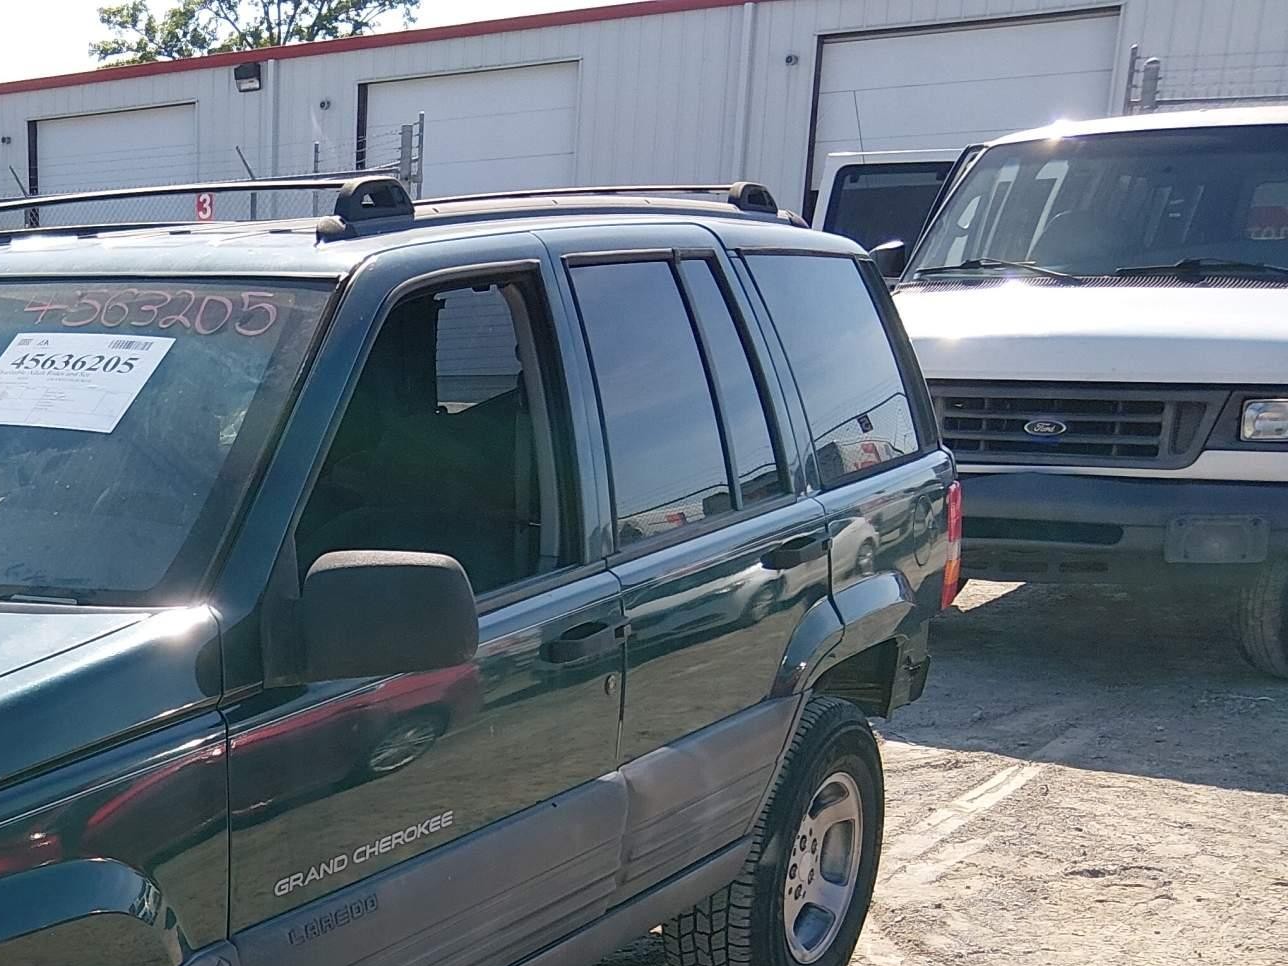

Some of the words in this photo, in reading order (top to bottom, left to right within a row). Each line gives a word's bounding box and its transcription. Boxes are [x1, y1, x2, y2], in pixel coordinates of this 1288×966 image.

[199, 193, 212, 220] 3
[10, 352, 140, 374] 45636205
[273, 853, 349, 898] GRAND
[352, 809, 455, 865] CHEROKEE
[287, 892, 379, 946] LAREDO
